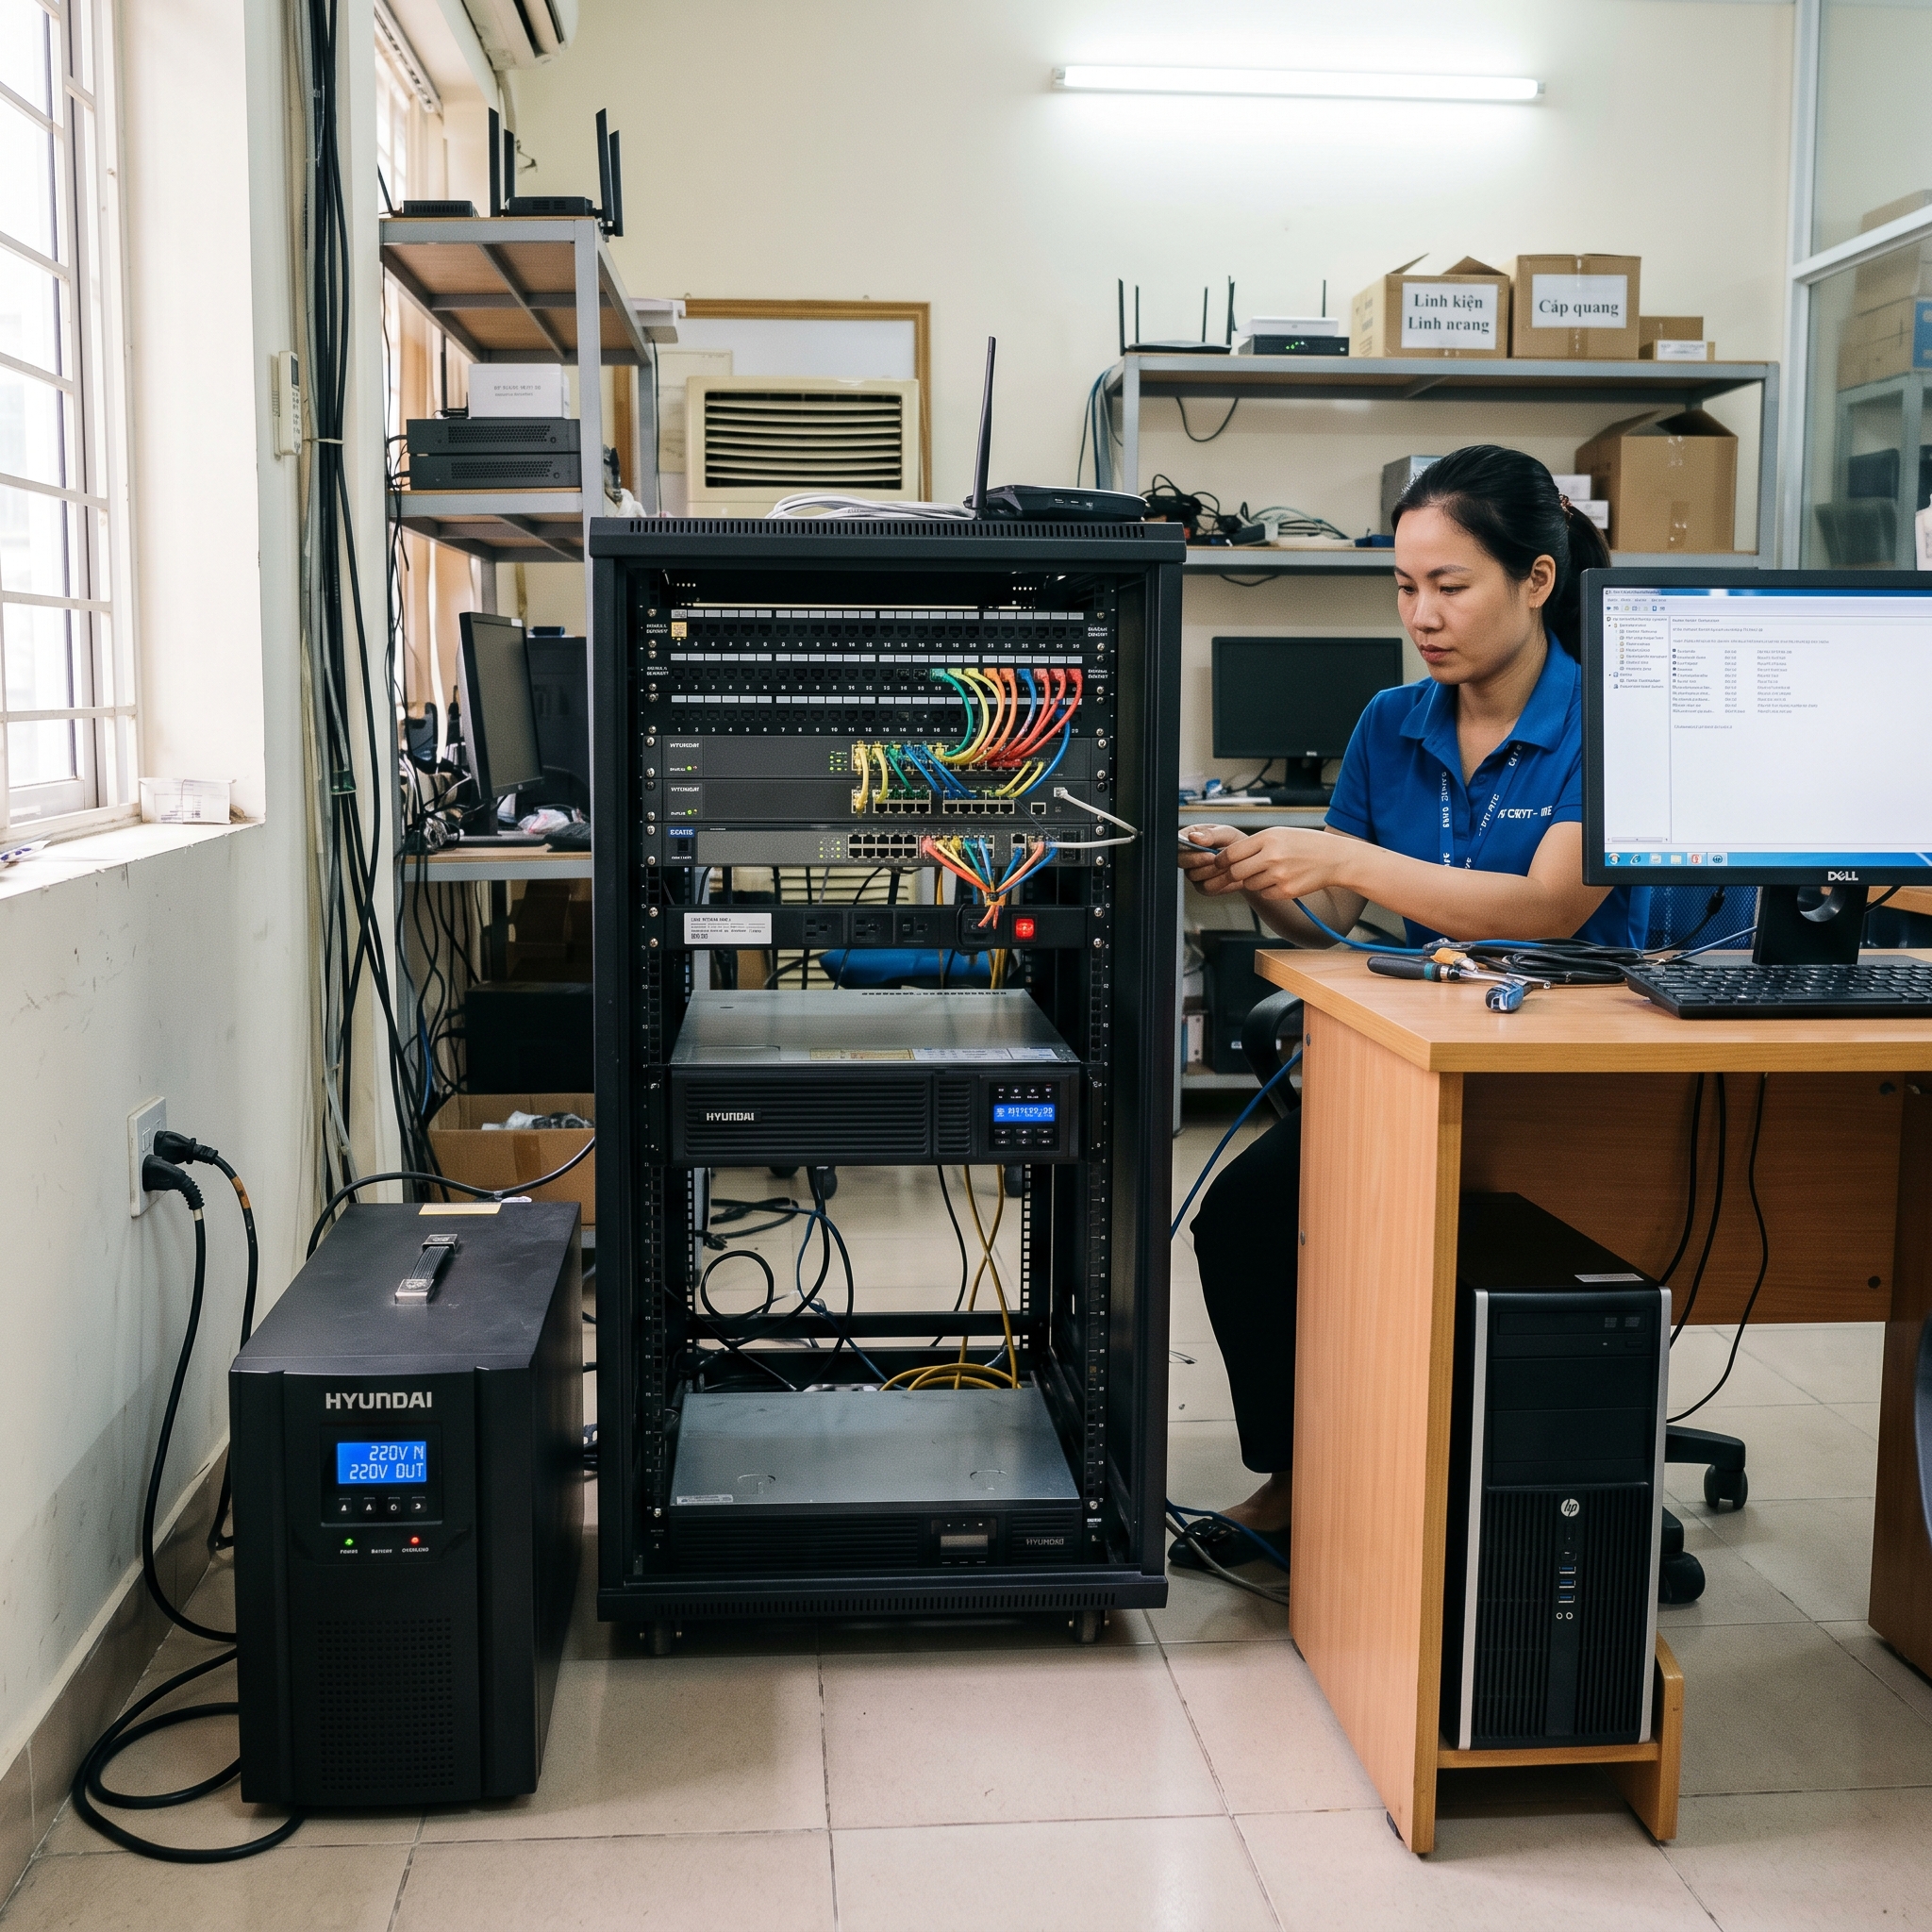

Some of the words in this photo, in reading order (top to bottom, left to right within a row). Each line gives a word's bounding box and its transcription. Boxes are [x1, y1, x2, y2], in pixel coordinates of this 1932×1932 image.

[1414, 293, 1448, 308] Linh
[1453, 294, 1483, 312] kiện
[1539, 299, 1569, 318] Cáp
[1573, 303, 1619, 318] quang
[1408, 316, 1441, 330] Linh
[1827, 871, 1859, 881] DELL
[706, 1112, 755, 1122] HYUNDAI
[325, 1391, 433, 1409] HYUNDAI
[369, 1445, 408, 1461] 220V
[349, 1463, 389, 1480] 220V
[395, 1462, 424, 1479] OUT
